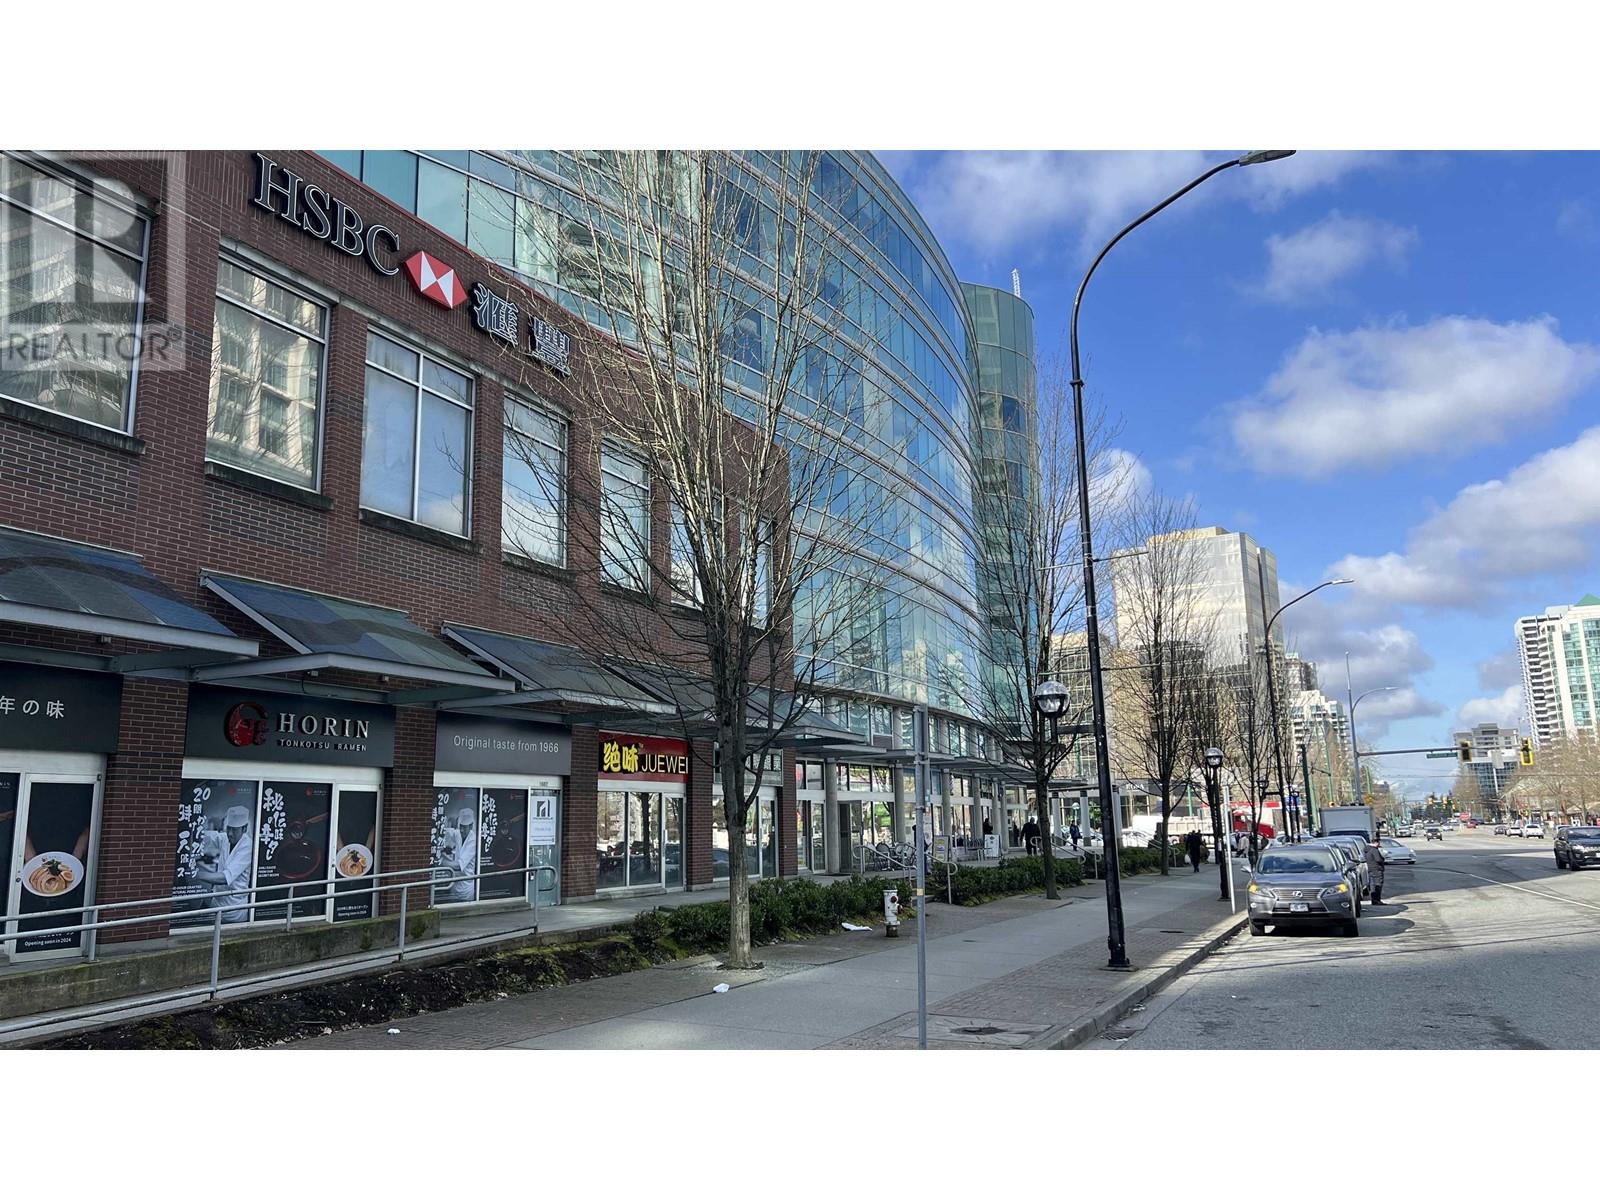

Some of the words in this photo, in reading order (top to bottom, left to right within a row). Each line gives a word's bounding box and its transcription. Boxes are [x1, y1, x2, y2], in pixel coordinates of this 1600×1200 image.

[253, 152, 401, 276] HSBC
[278, 712, 370, 739] HORIN
[280, 738, 330, 749] TONKOTSU
[337, 742, 367, 752] RAMEN
[453, 735, 491, 750] Original
[493, 740, 516, 750] taste
[518, 741, 537, 751] from
[539, 741, 559, 753] 1966
[641, 753, 689, 774] JUEWEI
